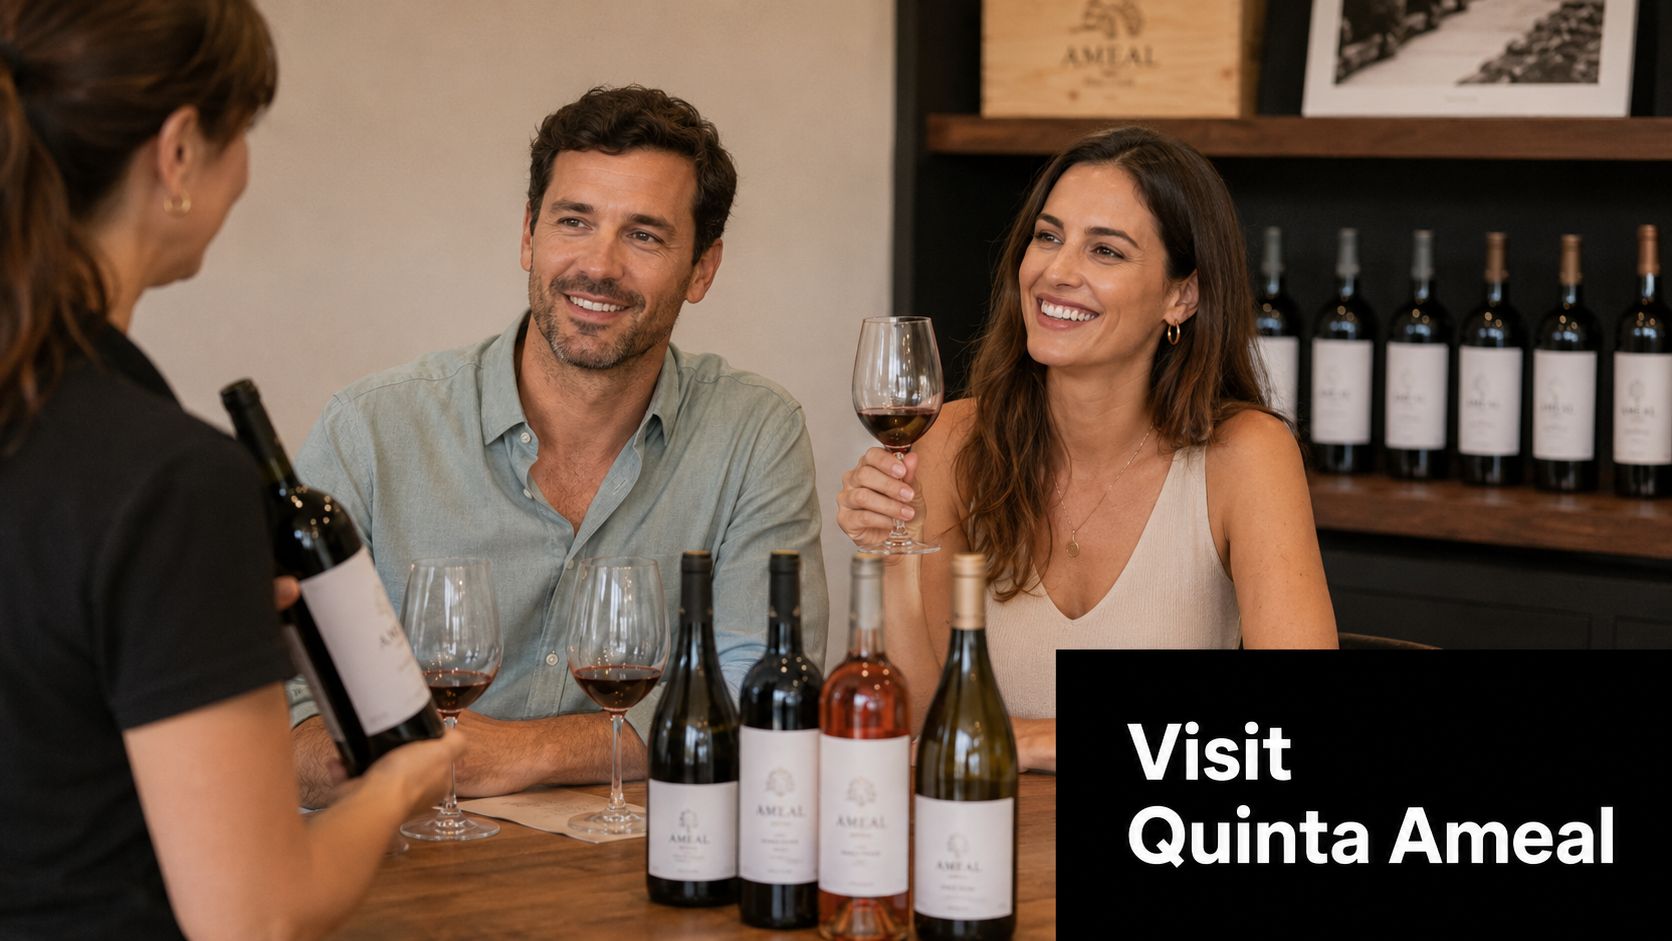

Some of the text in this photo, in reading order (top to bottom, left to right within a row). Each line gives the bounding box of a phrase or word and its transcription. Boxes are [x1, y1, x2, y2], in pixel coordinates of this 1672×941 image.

[1060, 45, 1159, 68] AMEAL
[755, 804, 806, 818] AMEAL
[836, 815, 887, 829] AMEAL
[668, 833, 711, 845] AMEAL
[936, 860, 983, 873] AMEAL
